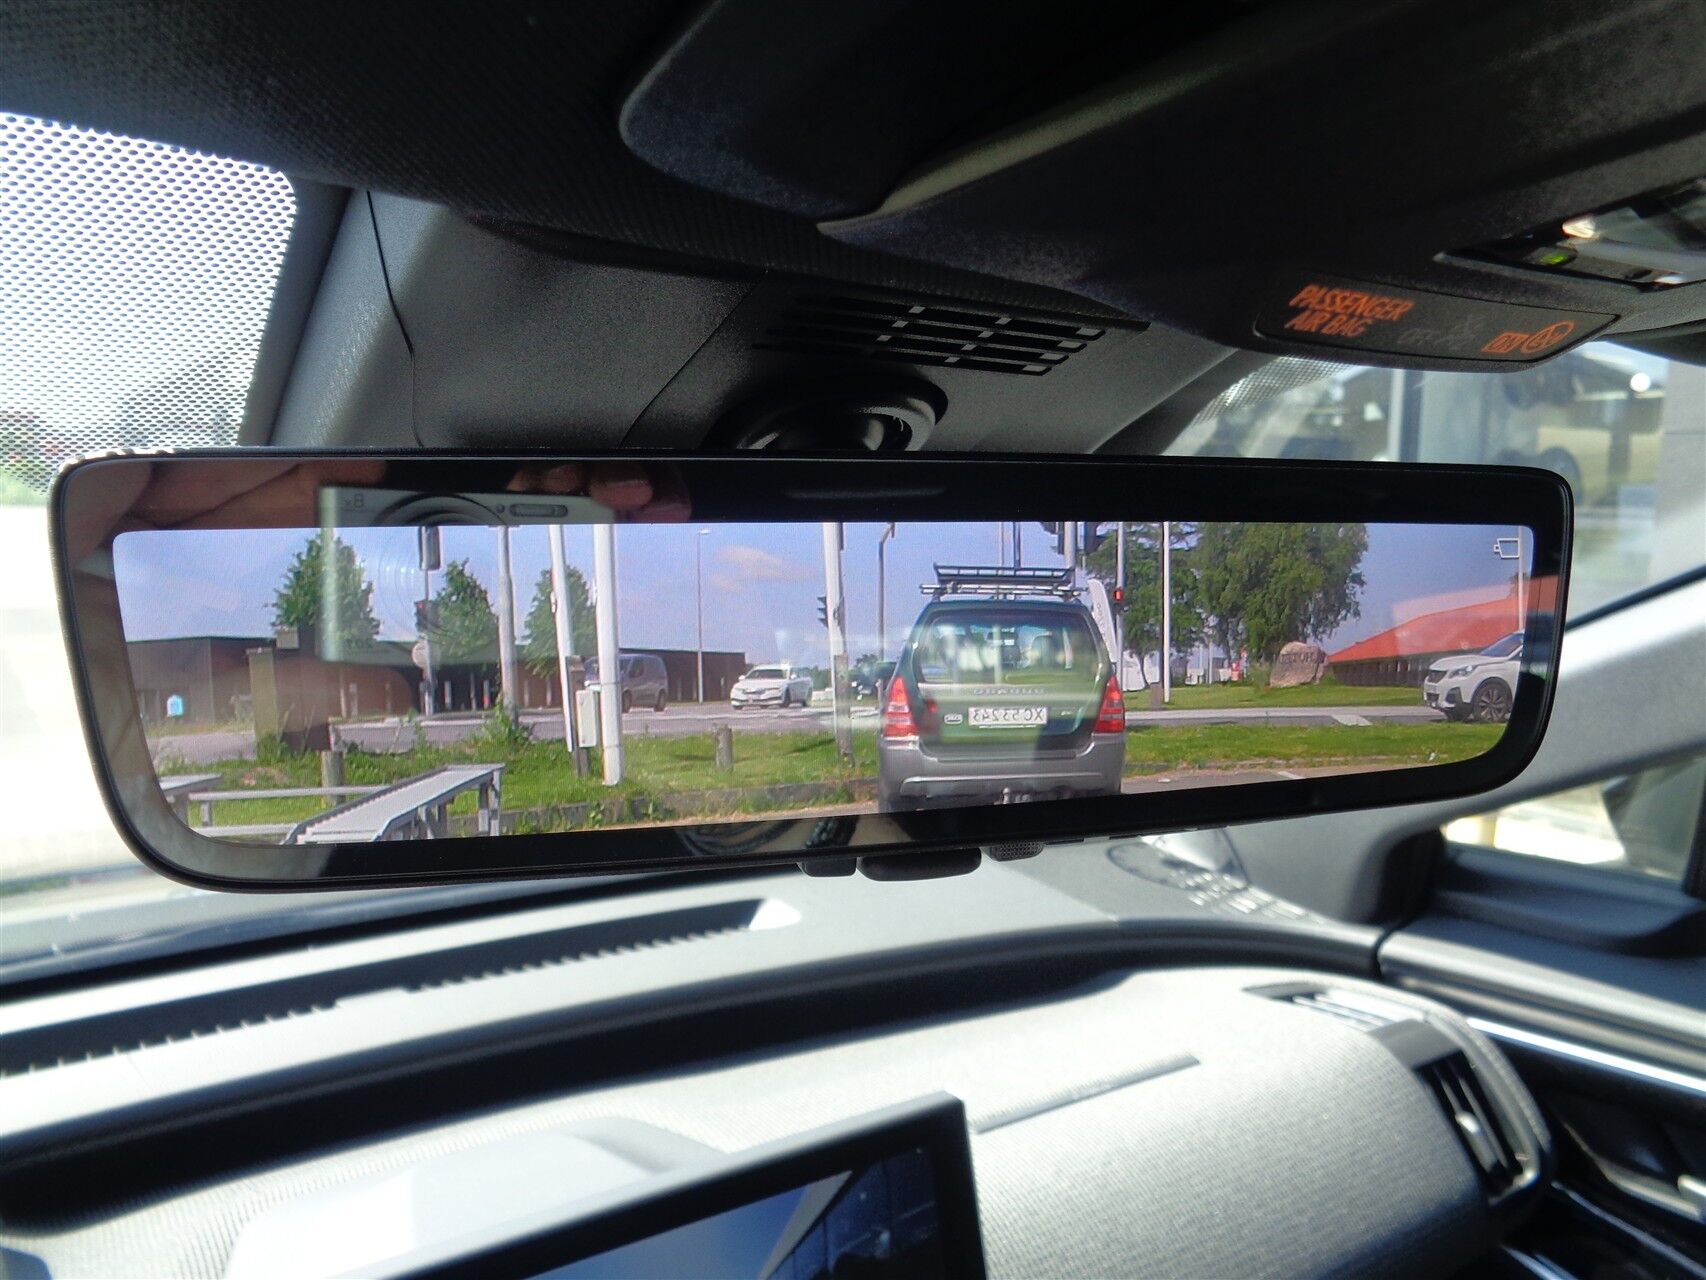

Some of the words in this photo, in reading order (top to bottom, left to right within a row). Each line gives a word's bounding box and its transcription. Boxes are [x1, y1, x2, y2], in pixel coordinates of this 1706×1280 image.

[1289, 285, 1414, 321] PASSENGER
[1284, 310, 1331, 333] AIR
[1321, 314, 1373, 337] BAG
